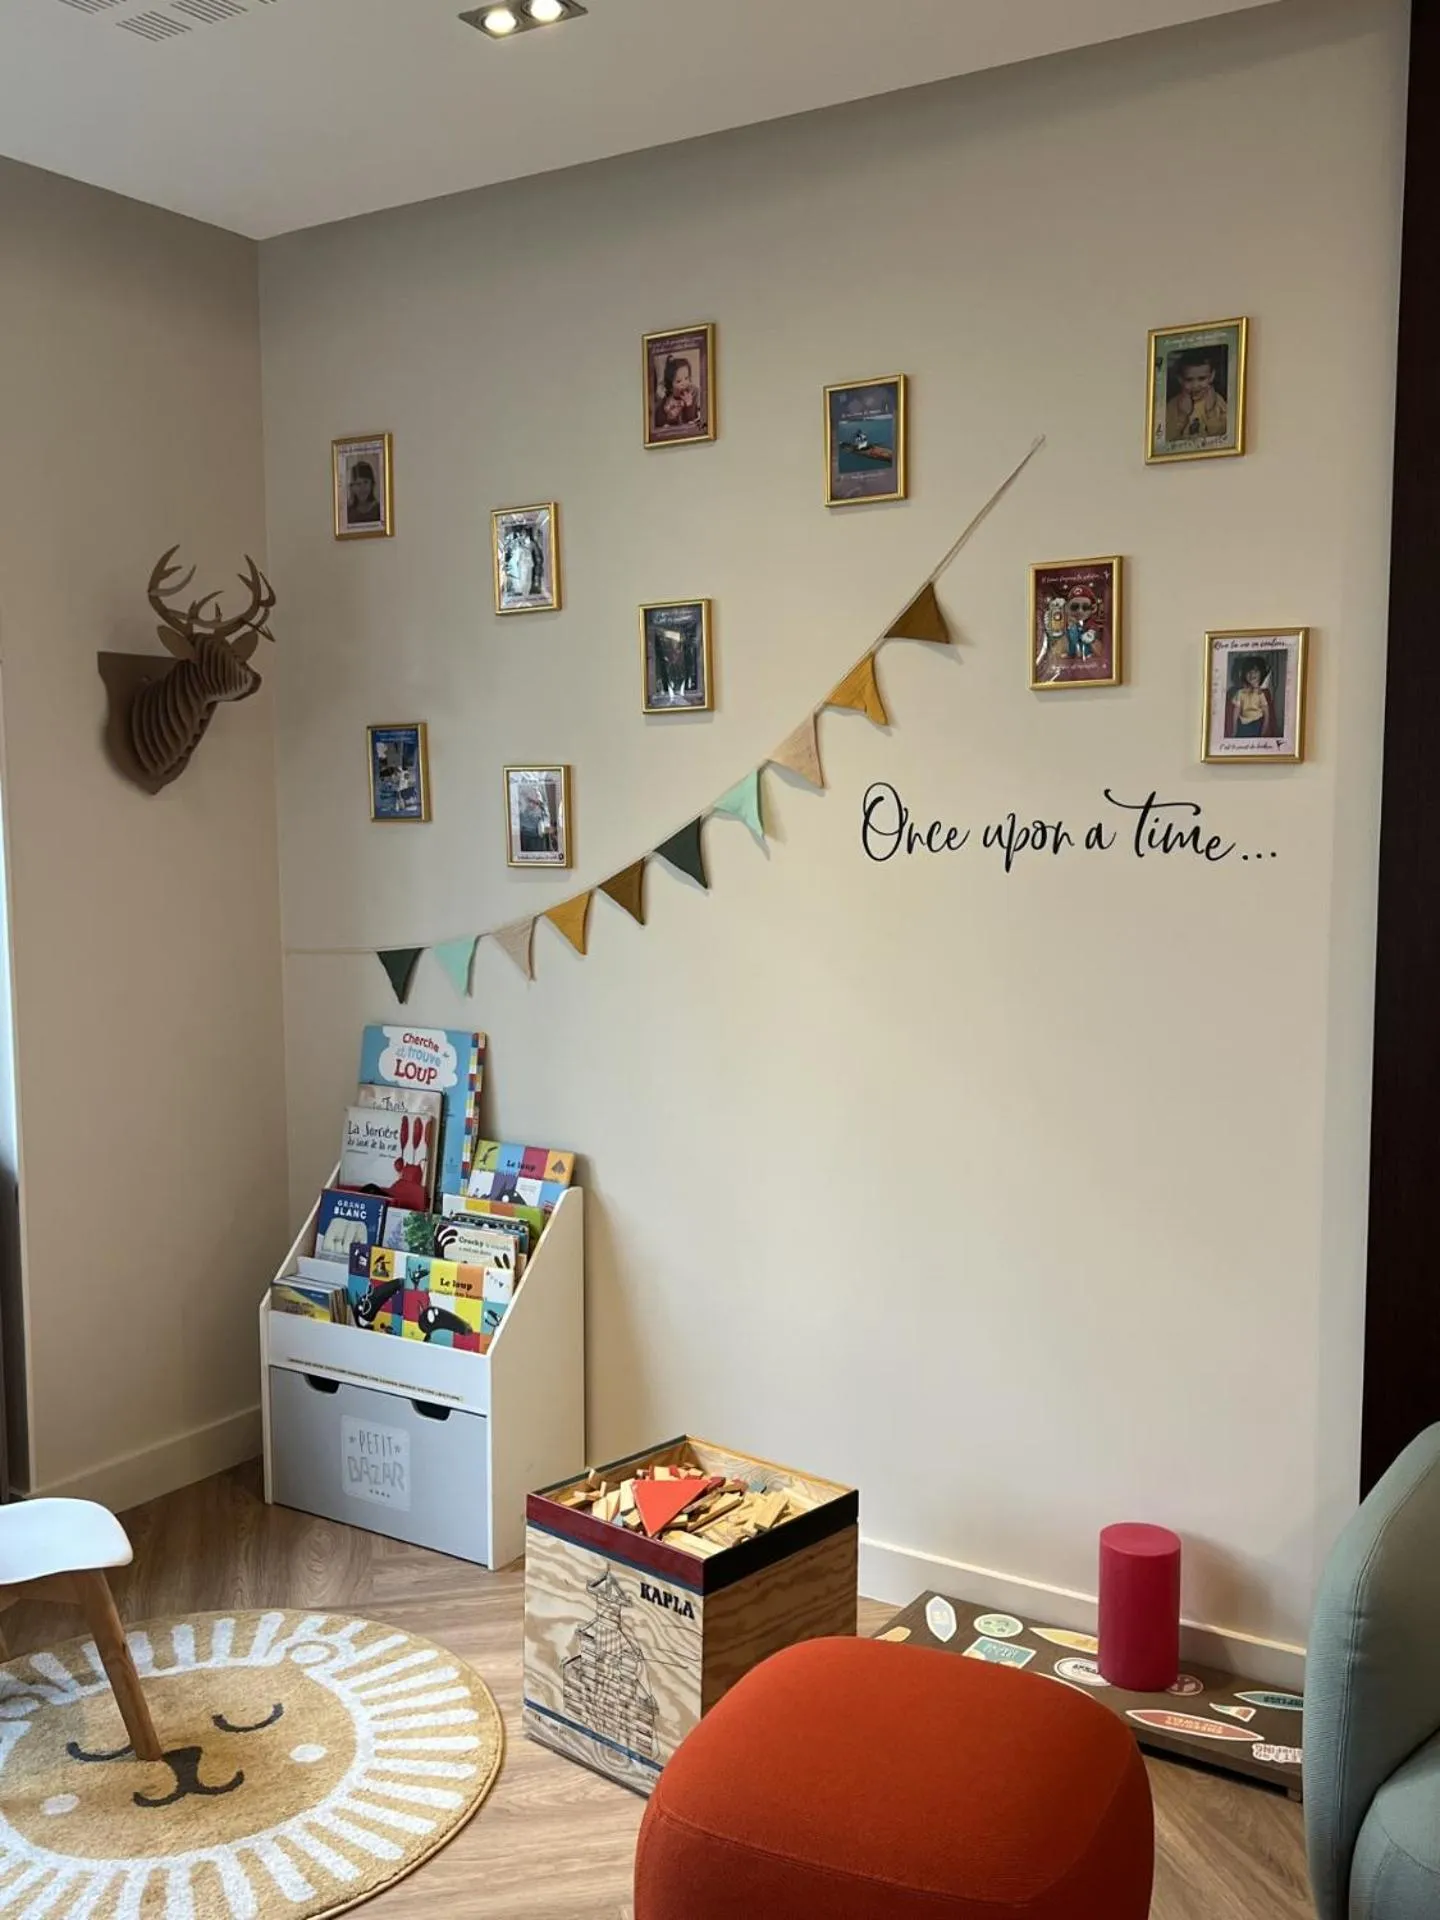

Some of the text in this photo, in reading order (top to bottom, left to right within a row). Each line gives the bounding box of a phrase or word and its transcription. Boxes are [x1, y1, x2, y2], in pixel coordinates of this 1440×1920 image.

[862, 782, 1278, 874] Once upon a time...
[402, 1032, 440, 1052] Cherche
[394, 1058, 438, 1085] LOUP
[346, 1120, 360, 1135] La
[333, 1205, 367, 1220] BLANC
[337, 1199, 366, 1210] GRAND
[440, 1277, 473, 1291] Le loup
[359, 1429, 393, 1457] PETIT
[347, 1455, 405, 1492] BAZAR
[640, 1581, 695, 1620] KAPLA
